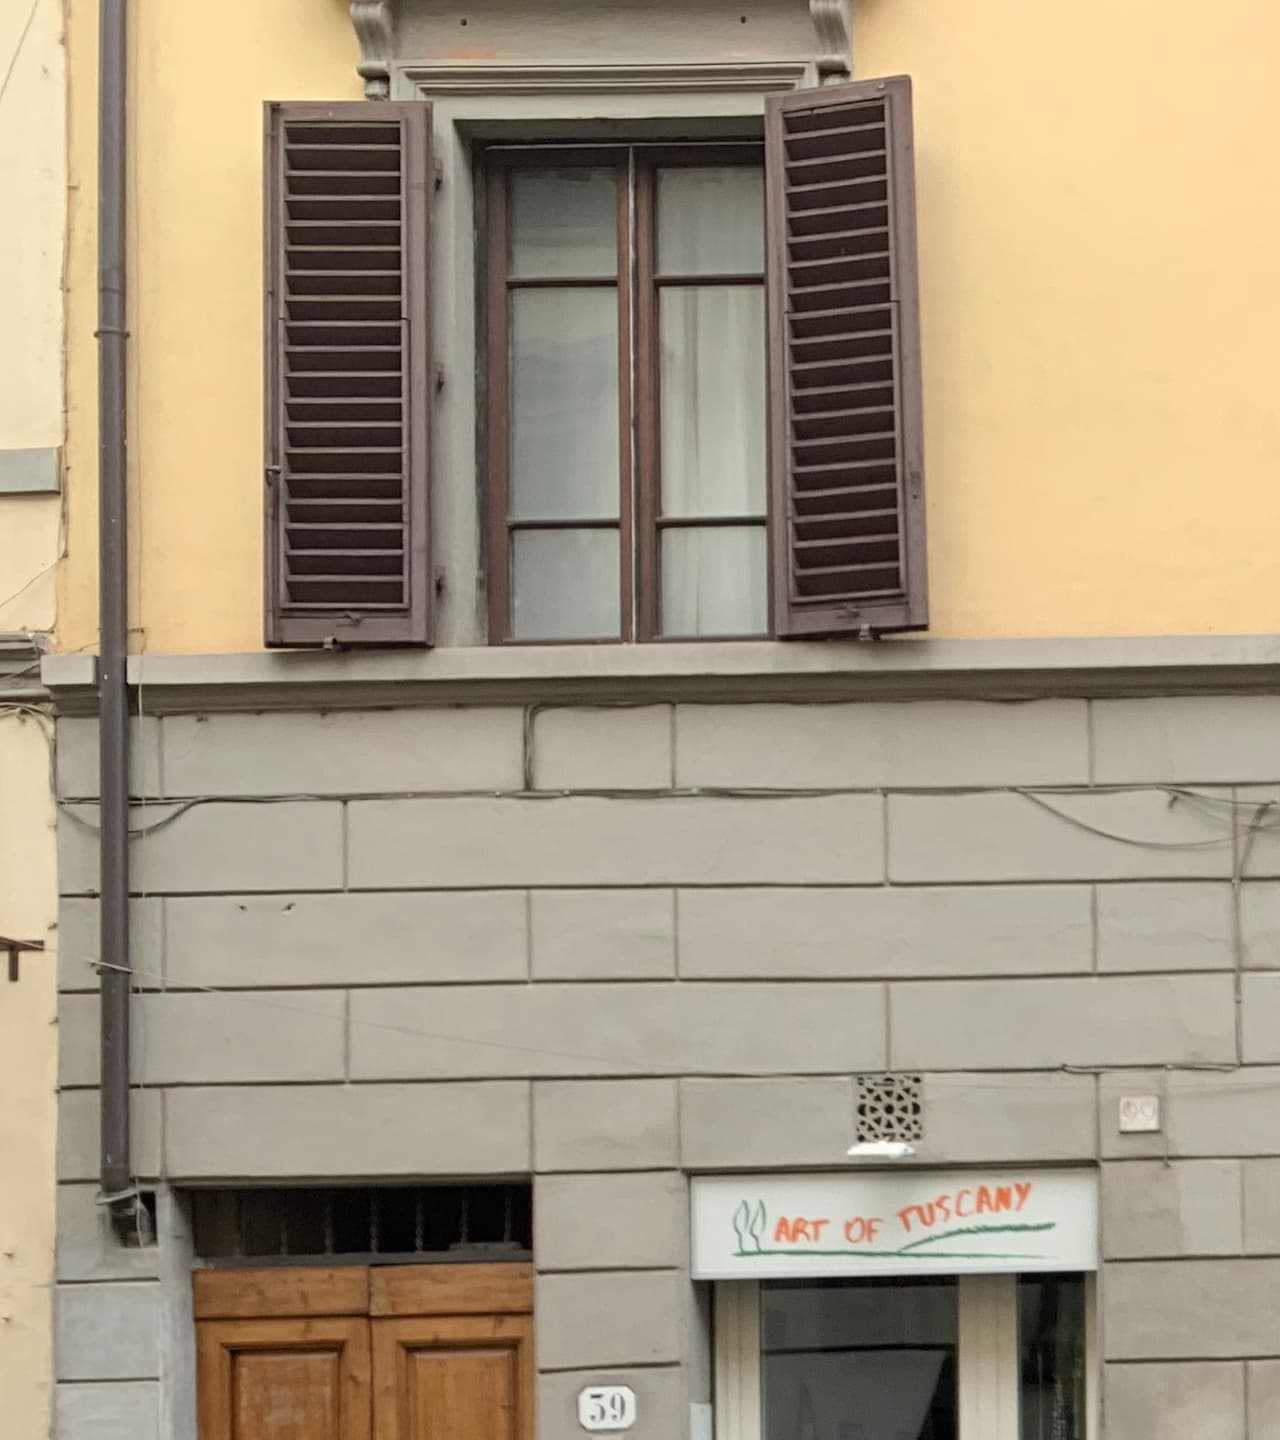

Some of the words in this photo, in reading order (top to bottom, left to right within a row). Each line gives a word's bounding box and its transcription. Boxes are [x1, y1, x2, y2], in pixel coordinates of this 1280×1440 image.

[773, 1215, 829, 1244] ART
[844, 1215, 886, 1244] OF
[897, 1181, 1034, 1234] TUSCANY
